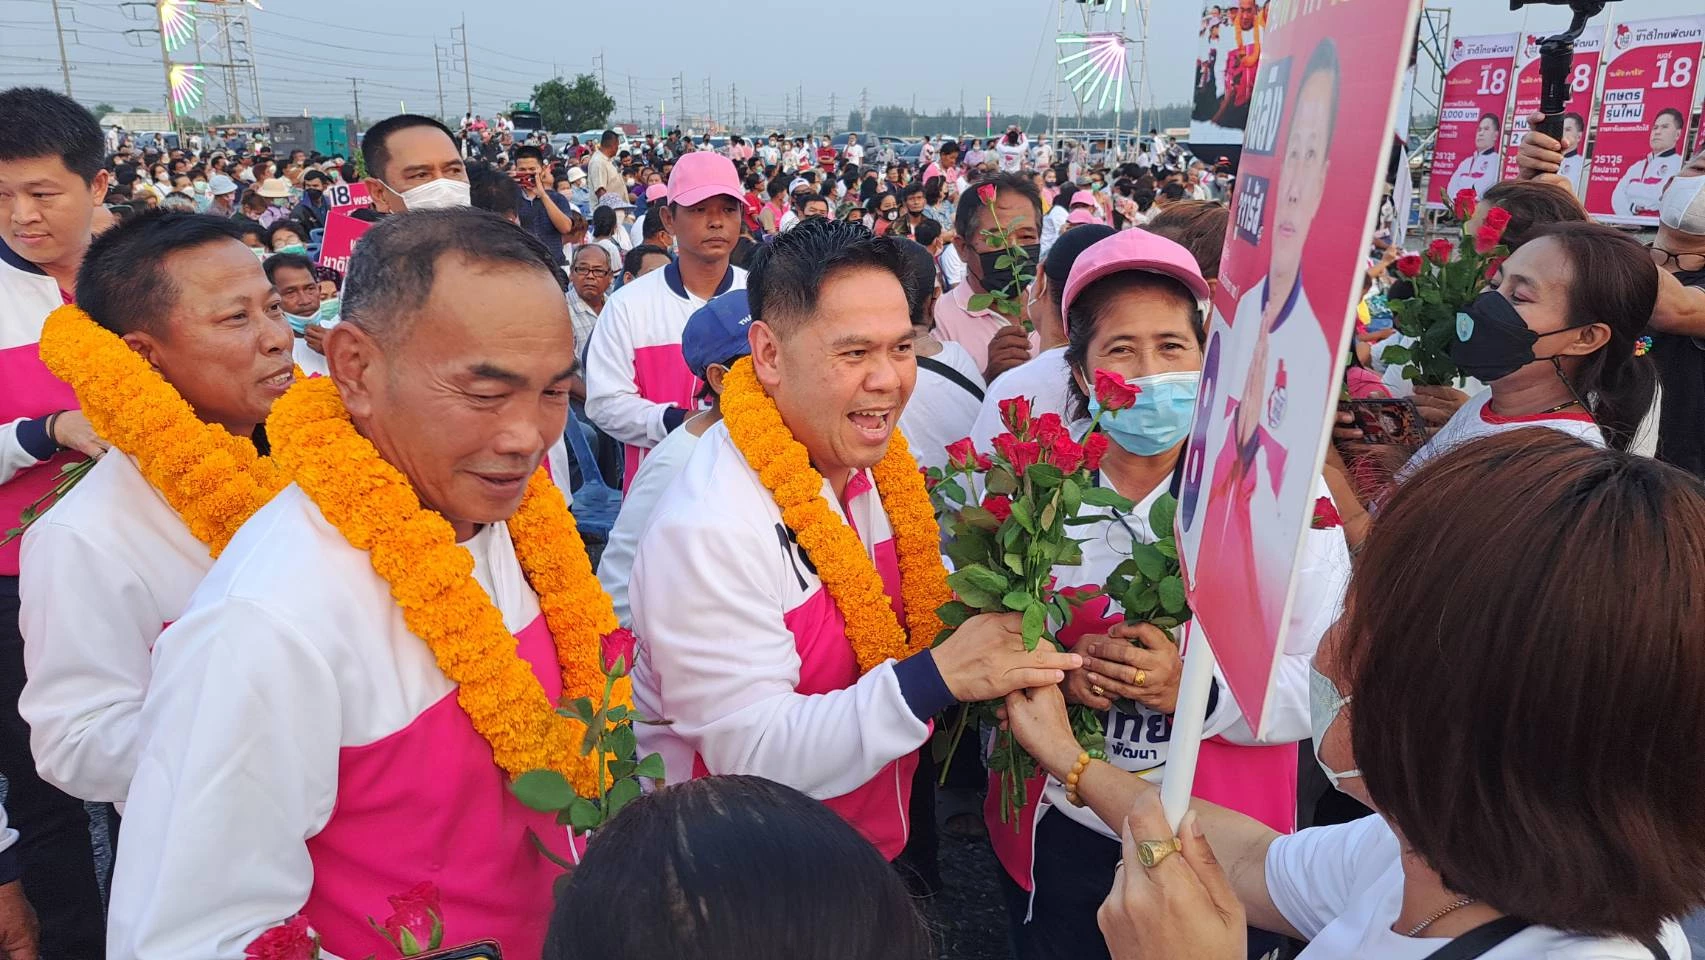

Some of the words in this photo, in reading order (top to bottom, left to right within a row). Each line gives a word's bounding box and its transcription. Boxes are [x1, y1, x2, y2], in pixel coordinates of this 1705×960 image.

[1636, 28, 1702, 41] ชาติไทยพัฒนา
[1476, 68, 1507, 95] 18
[1570, 63, 1592, 93] 8
[1651, 57, 1693, 89] 18
[1605, 91, 1641, 102] เกษตร
[1442, 111, 1464, 120] 3,000
[1605, 104, 1643, 122] รุ่นใหม่
[329, 185, 350, 205] 18
[1112, 741, 1157, 760] พัฒนา
